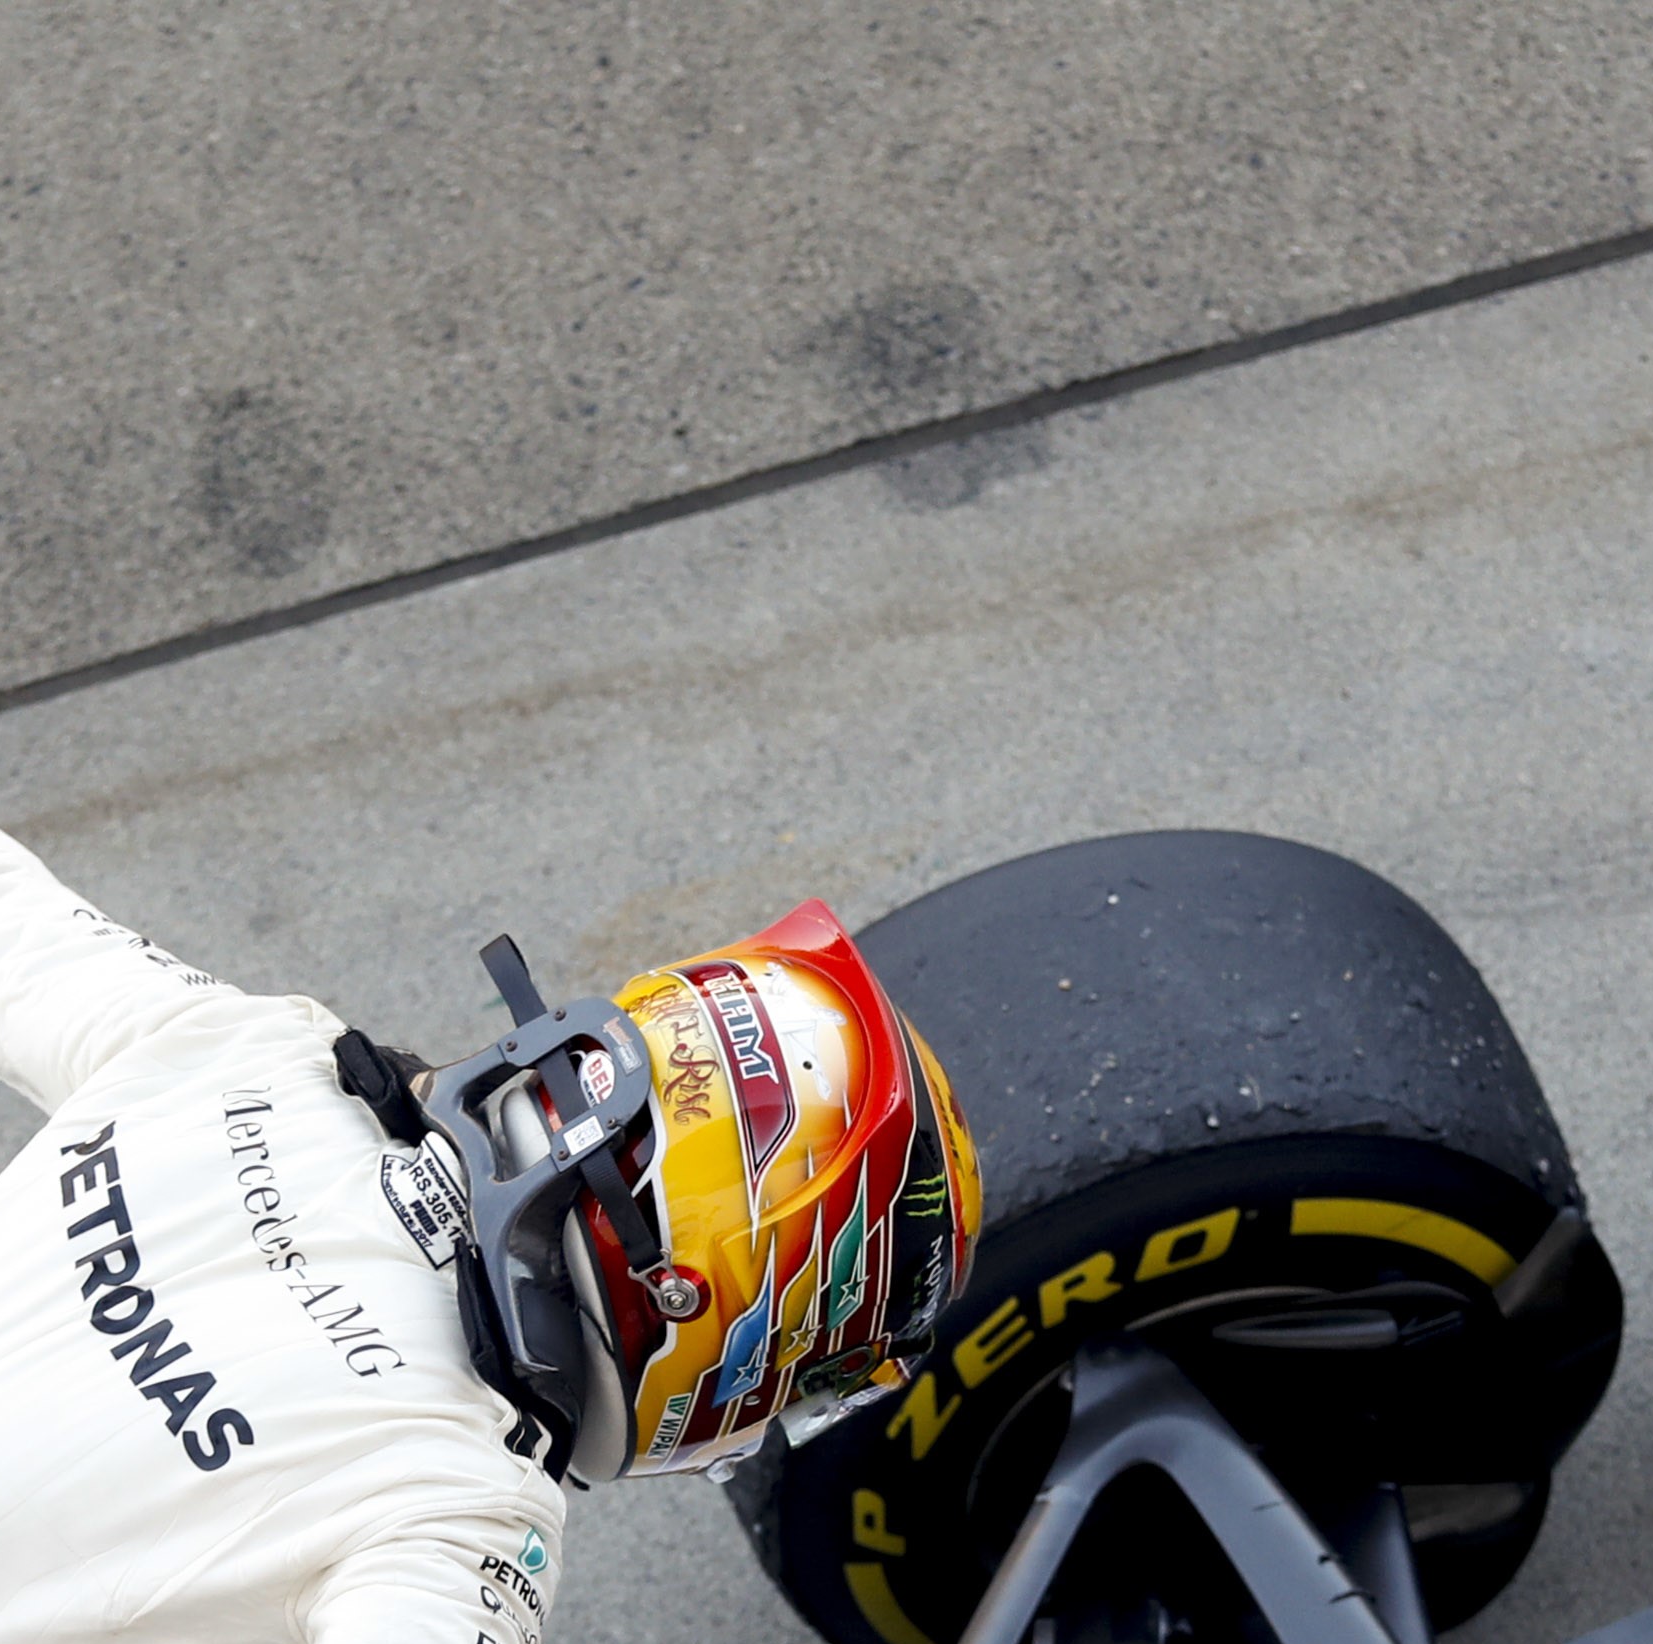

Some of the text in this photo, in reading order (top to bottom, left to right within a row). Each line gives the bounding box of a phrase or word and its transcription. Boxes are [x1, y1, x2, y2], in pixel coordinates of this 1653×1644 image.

[60, 1120, 255, 1472] PETRONAS
[222, 1085, 407, 1379] Mercedes-AMG
[886, 1206, 1241, 1462] ZERO
